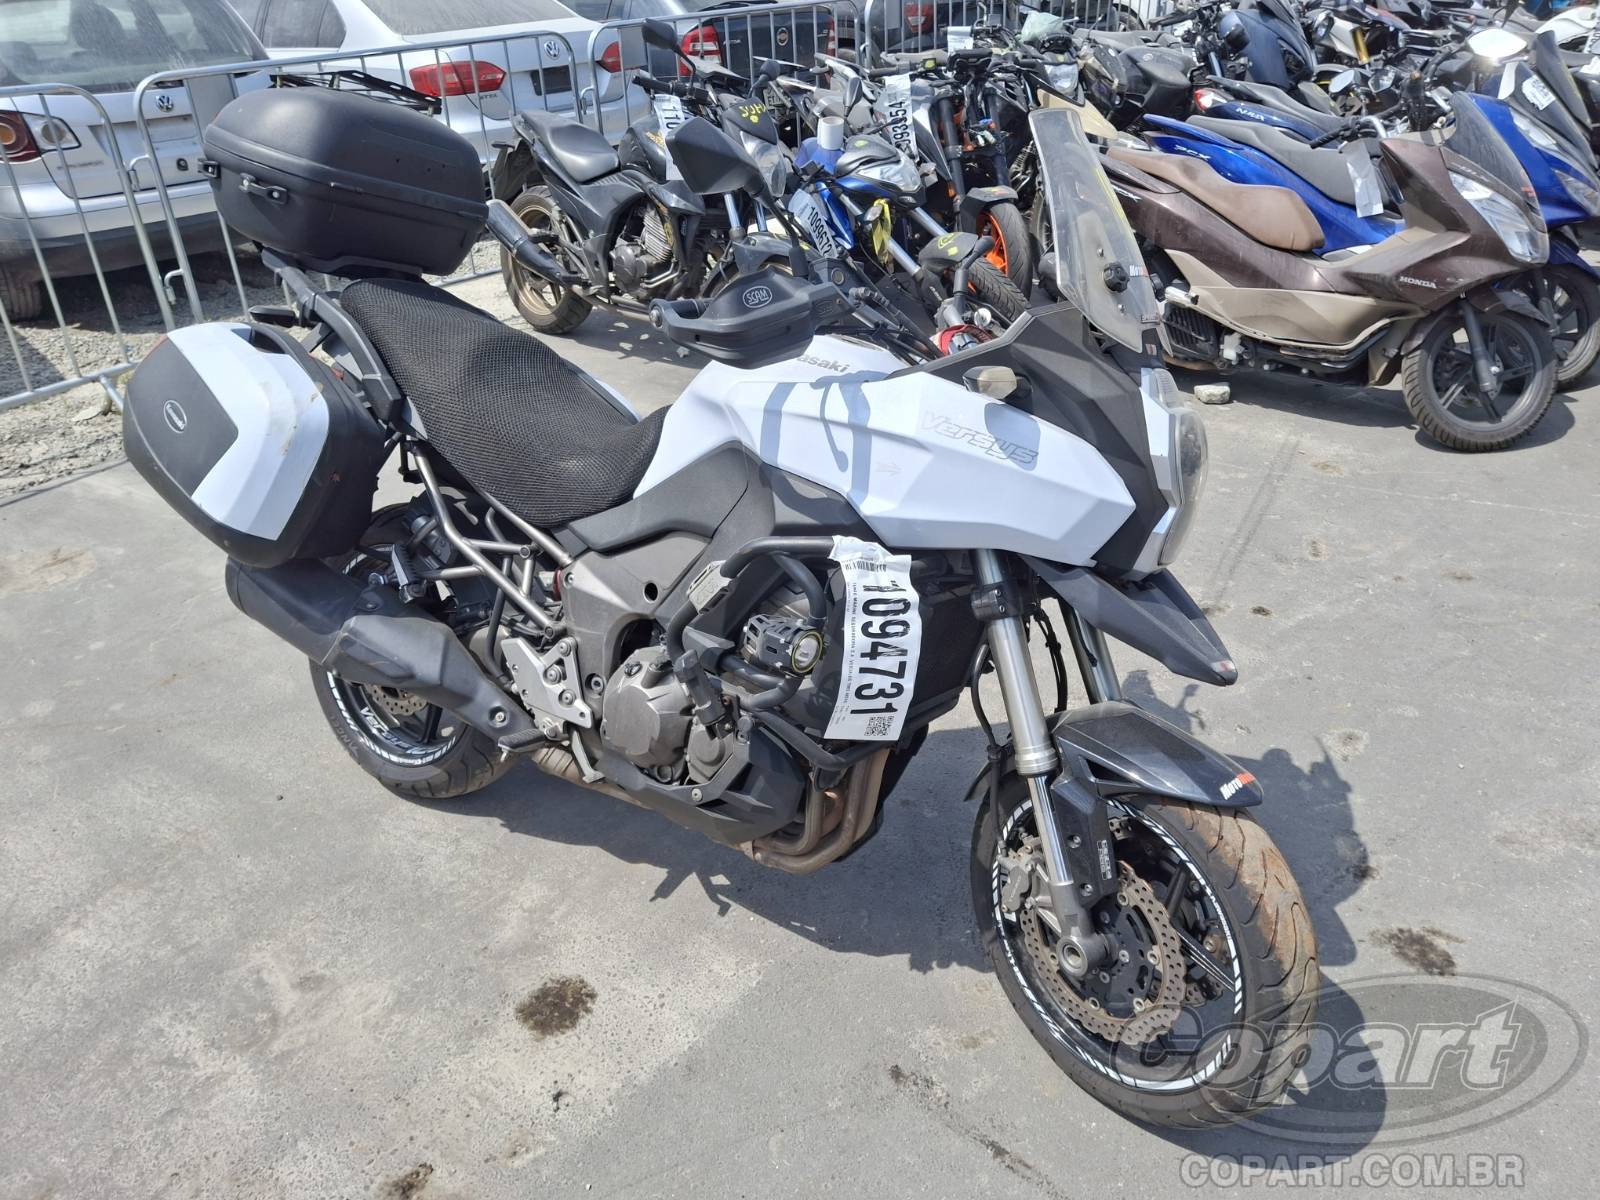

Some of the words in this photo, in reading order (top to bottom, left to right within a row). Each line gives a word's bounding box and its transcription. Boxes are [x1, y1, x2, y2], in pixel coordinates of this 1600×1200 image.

[807, 206, 832, 256] 1099672
[1400, 275, 1437, 289] HONDA
[797, 354, 851, 373] asaki
[922, 410, 1039, 464] Versys
[850, 580, 911, 715] 1094731
